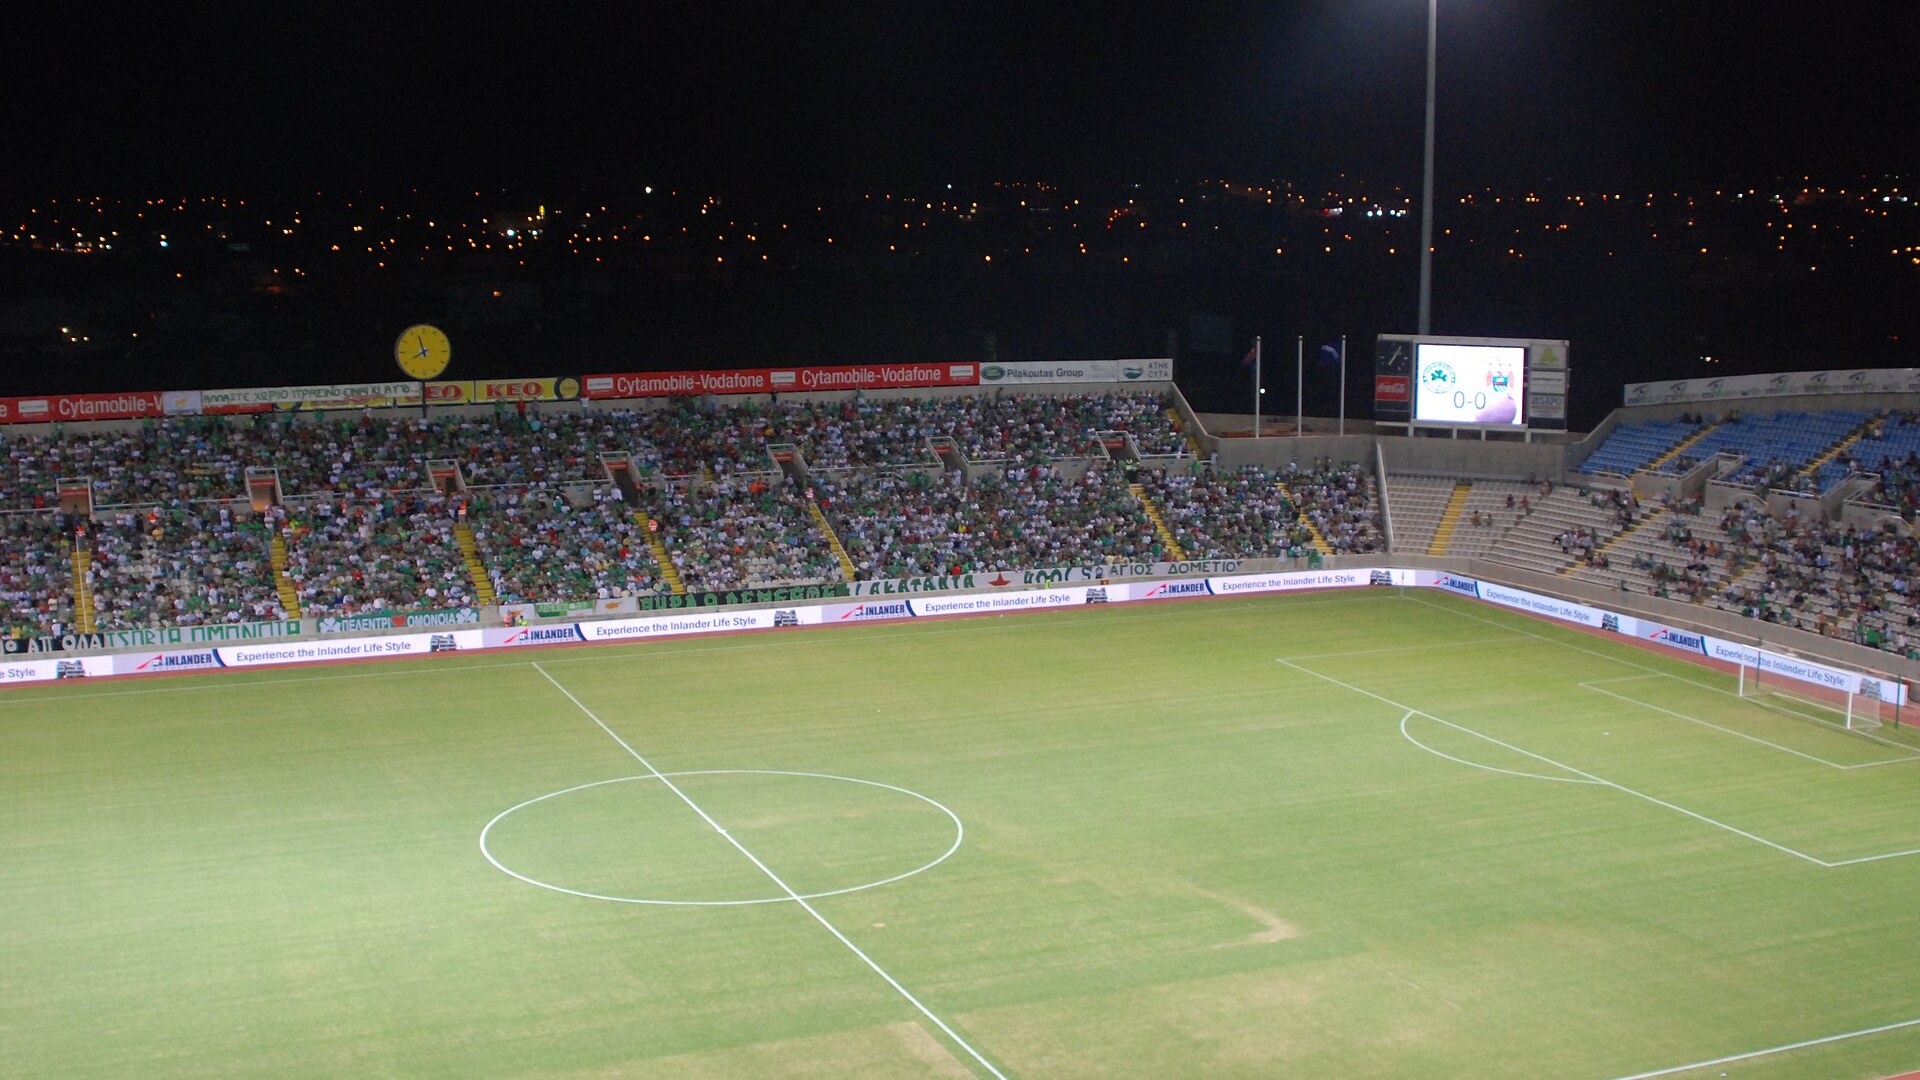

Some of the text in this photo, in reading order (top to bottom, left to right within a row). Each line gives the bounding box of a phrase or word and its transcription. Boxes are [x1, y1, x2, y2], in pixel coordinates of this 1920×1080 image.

[802, 366, 941, 387] Cytamobile-Vodafone
[1007, 368, 1053, 378] Pilakoutas
[1056, 367, 1083, 379] Group
[486, 381, 543, 398] KEO
[617, 374, 763, 395] Cytamobile-Vodafone
[1454, 391, 1486, 409] 0-0
[1169, 582, 1204, 594] INLANDER
[1223, 581, 1266, 591] Experience
[1268, 579, 1281, 587] the
[1283, 577, 1315, 586] Inlander
[1335, 574, 1356, 583] Style
[1450, 578, 1475, 593] INLANDER
[865, 604, 905, 616] INLANDER
[925, 594, 1071, 613] Experience the Inlander Life Style
[1487, 588, 1520, 604] Experience
[1560, 603, 1572, 616] Life
[1573, 609, 1590, 622] Style
[407, 613, 457, 627] ΟΜΟΝΟΙΑ
[597, 616, 757, 638] Experience the Inlander Life Style
[530, 628, 574, 641] INLANDER
[1669, 632, 1701, 649] INLANDER
[165, 652, 212, 667] INLANDER
[237, 640, 411, 662] Experience the Inlander Life Style
[1716, 647, 1758, 664] Experience
[8, 667, 36, 680] Style
